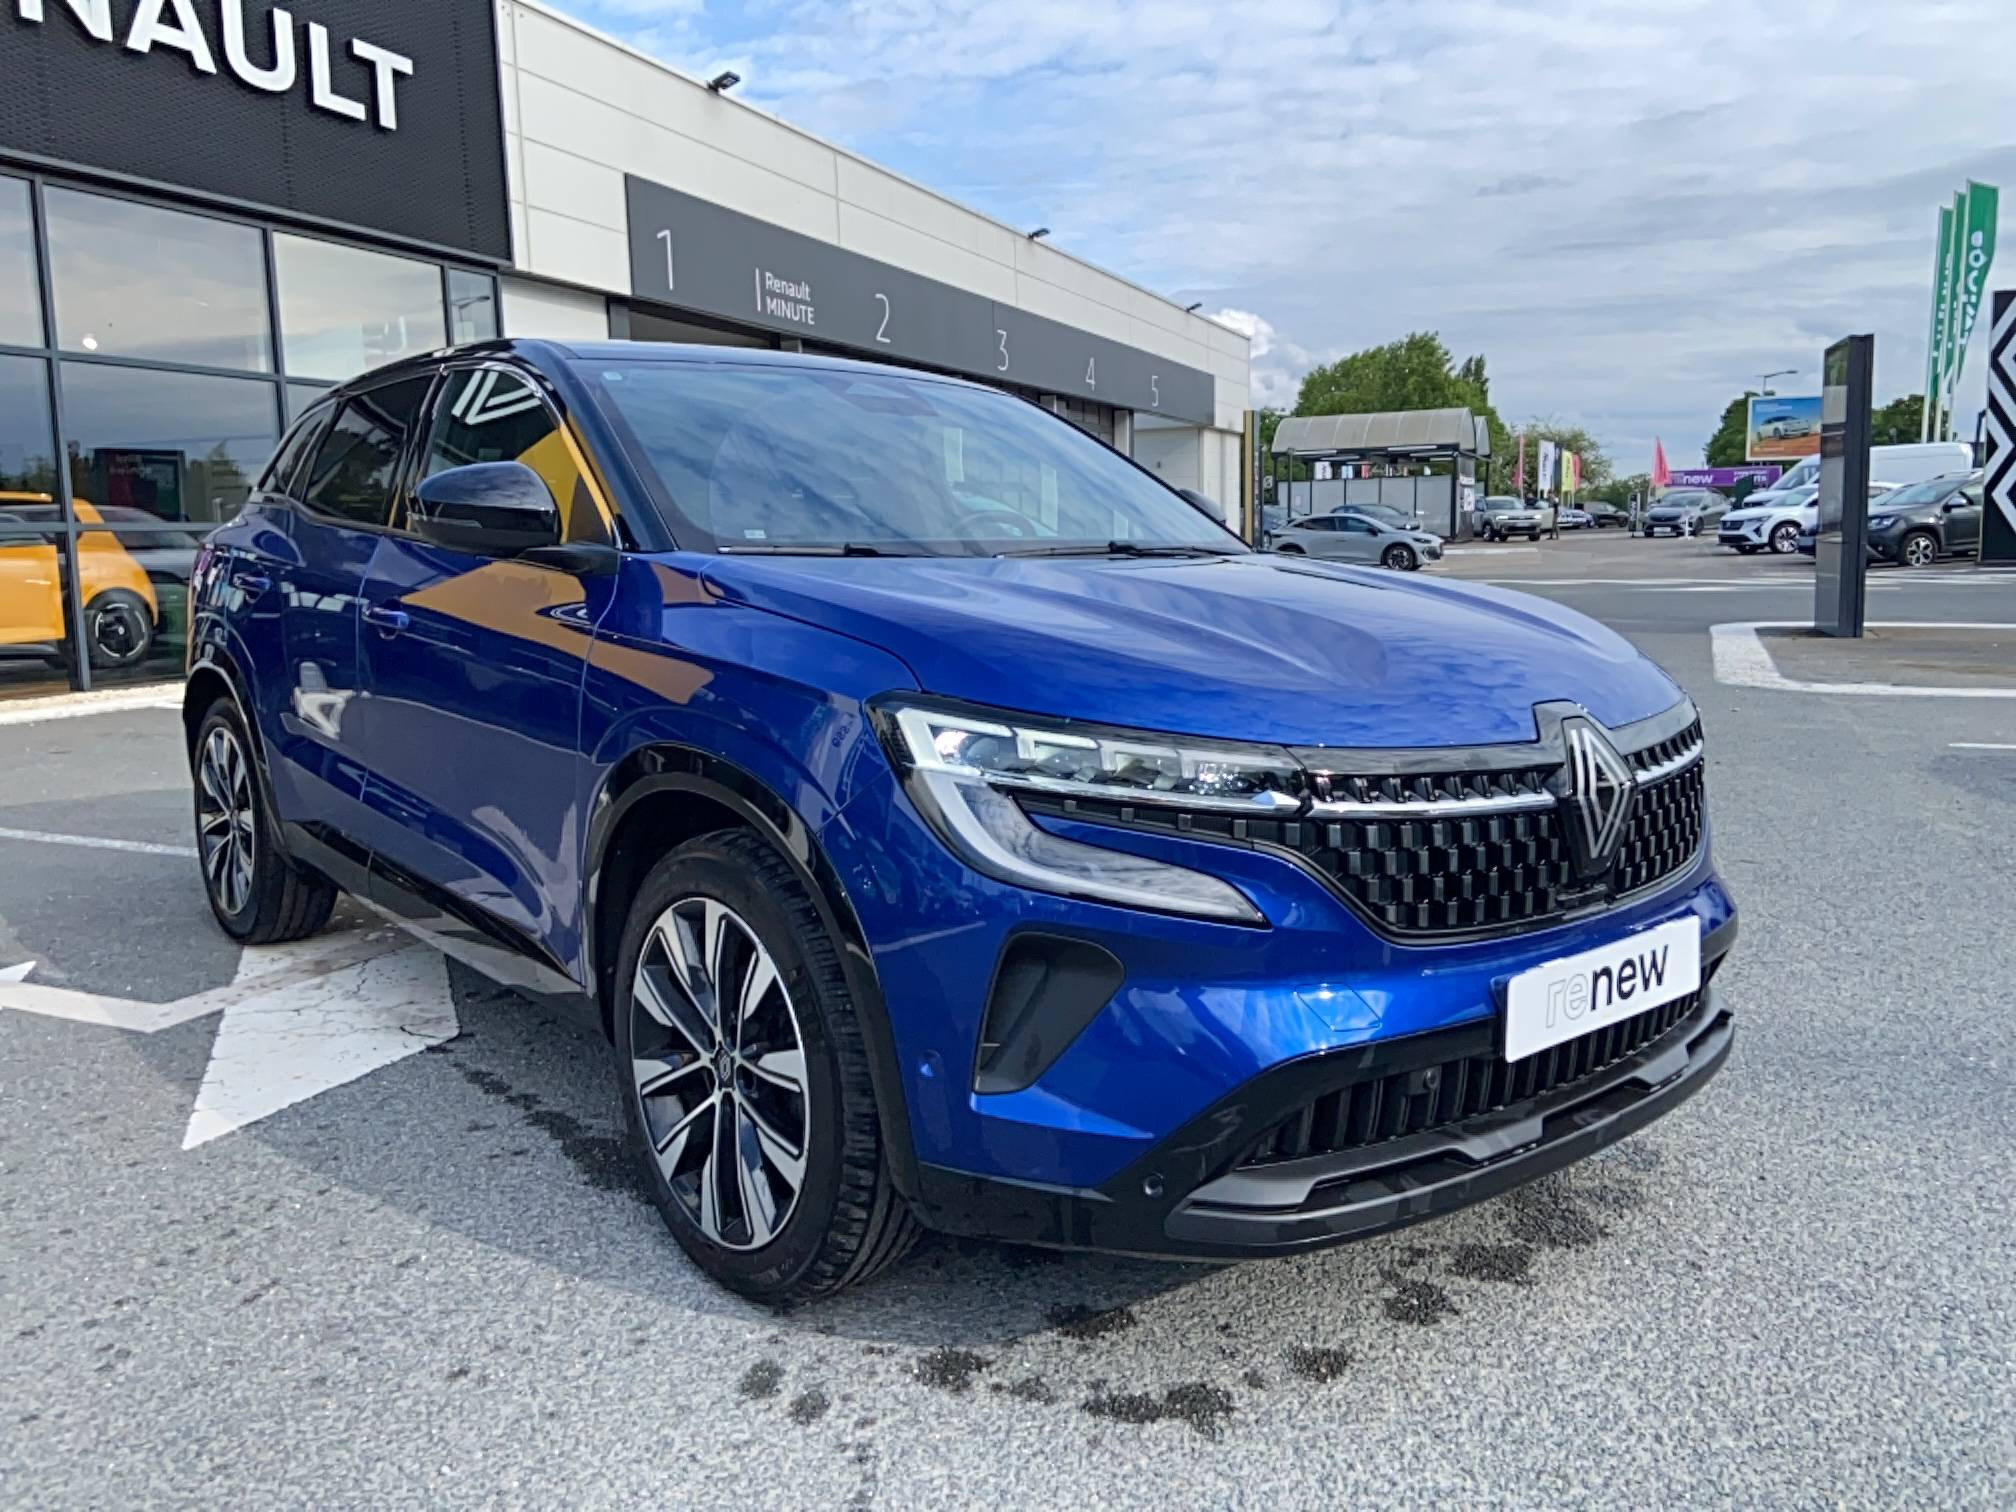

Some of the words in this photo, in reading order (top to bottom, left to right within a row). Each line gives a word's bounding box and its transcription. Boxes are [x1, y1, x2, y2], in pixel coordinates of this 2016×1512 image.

[656, 229, 674, 291] 1
[765, 271, 811, 302] Renault
[766, 295, 816, 325] MINUTE
[875, 293, 891, 343] 2
[996, 329, 1009, 371] 3
[1085, 357, 1096, 392] 4
[1151, 375, 1159, 407] 5
[1545, 944, 1669, 1029] renew
